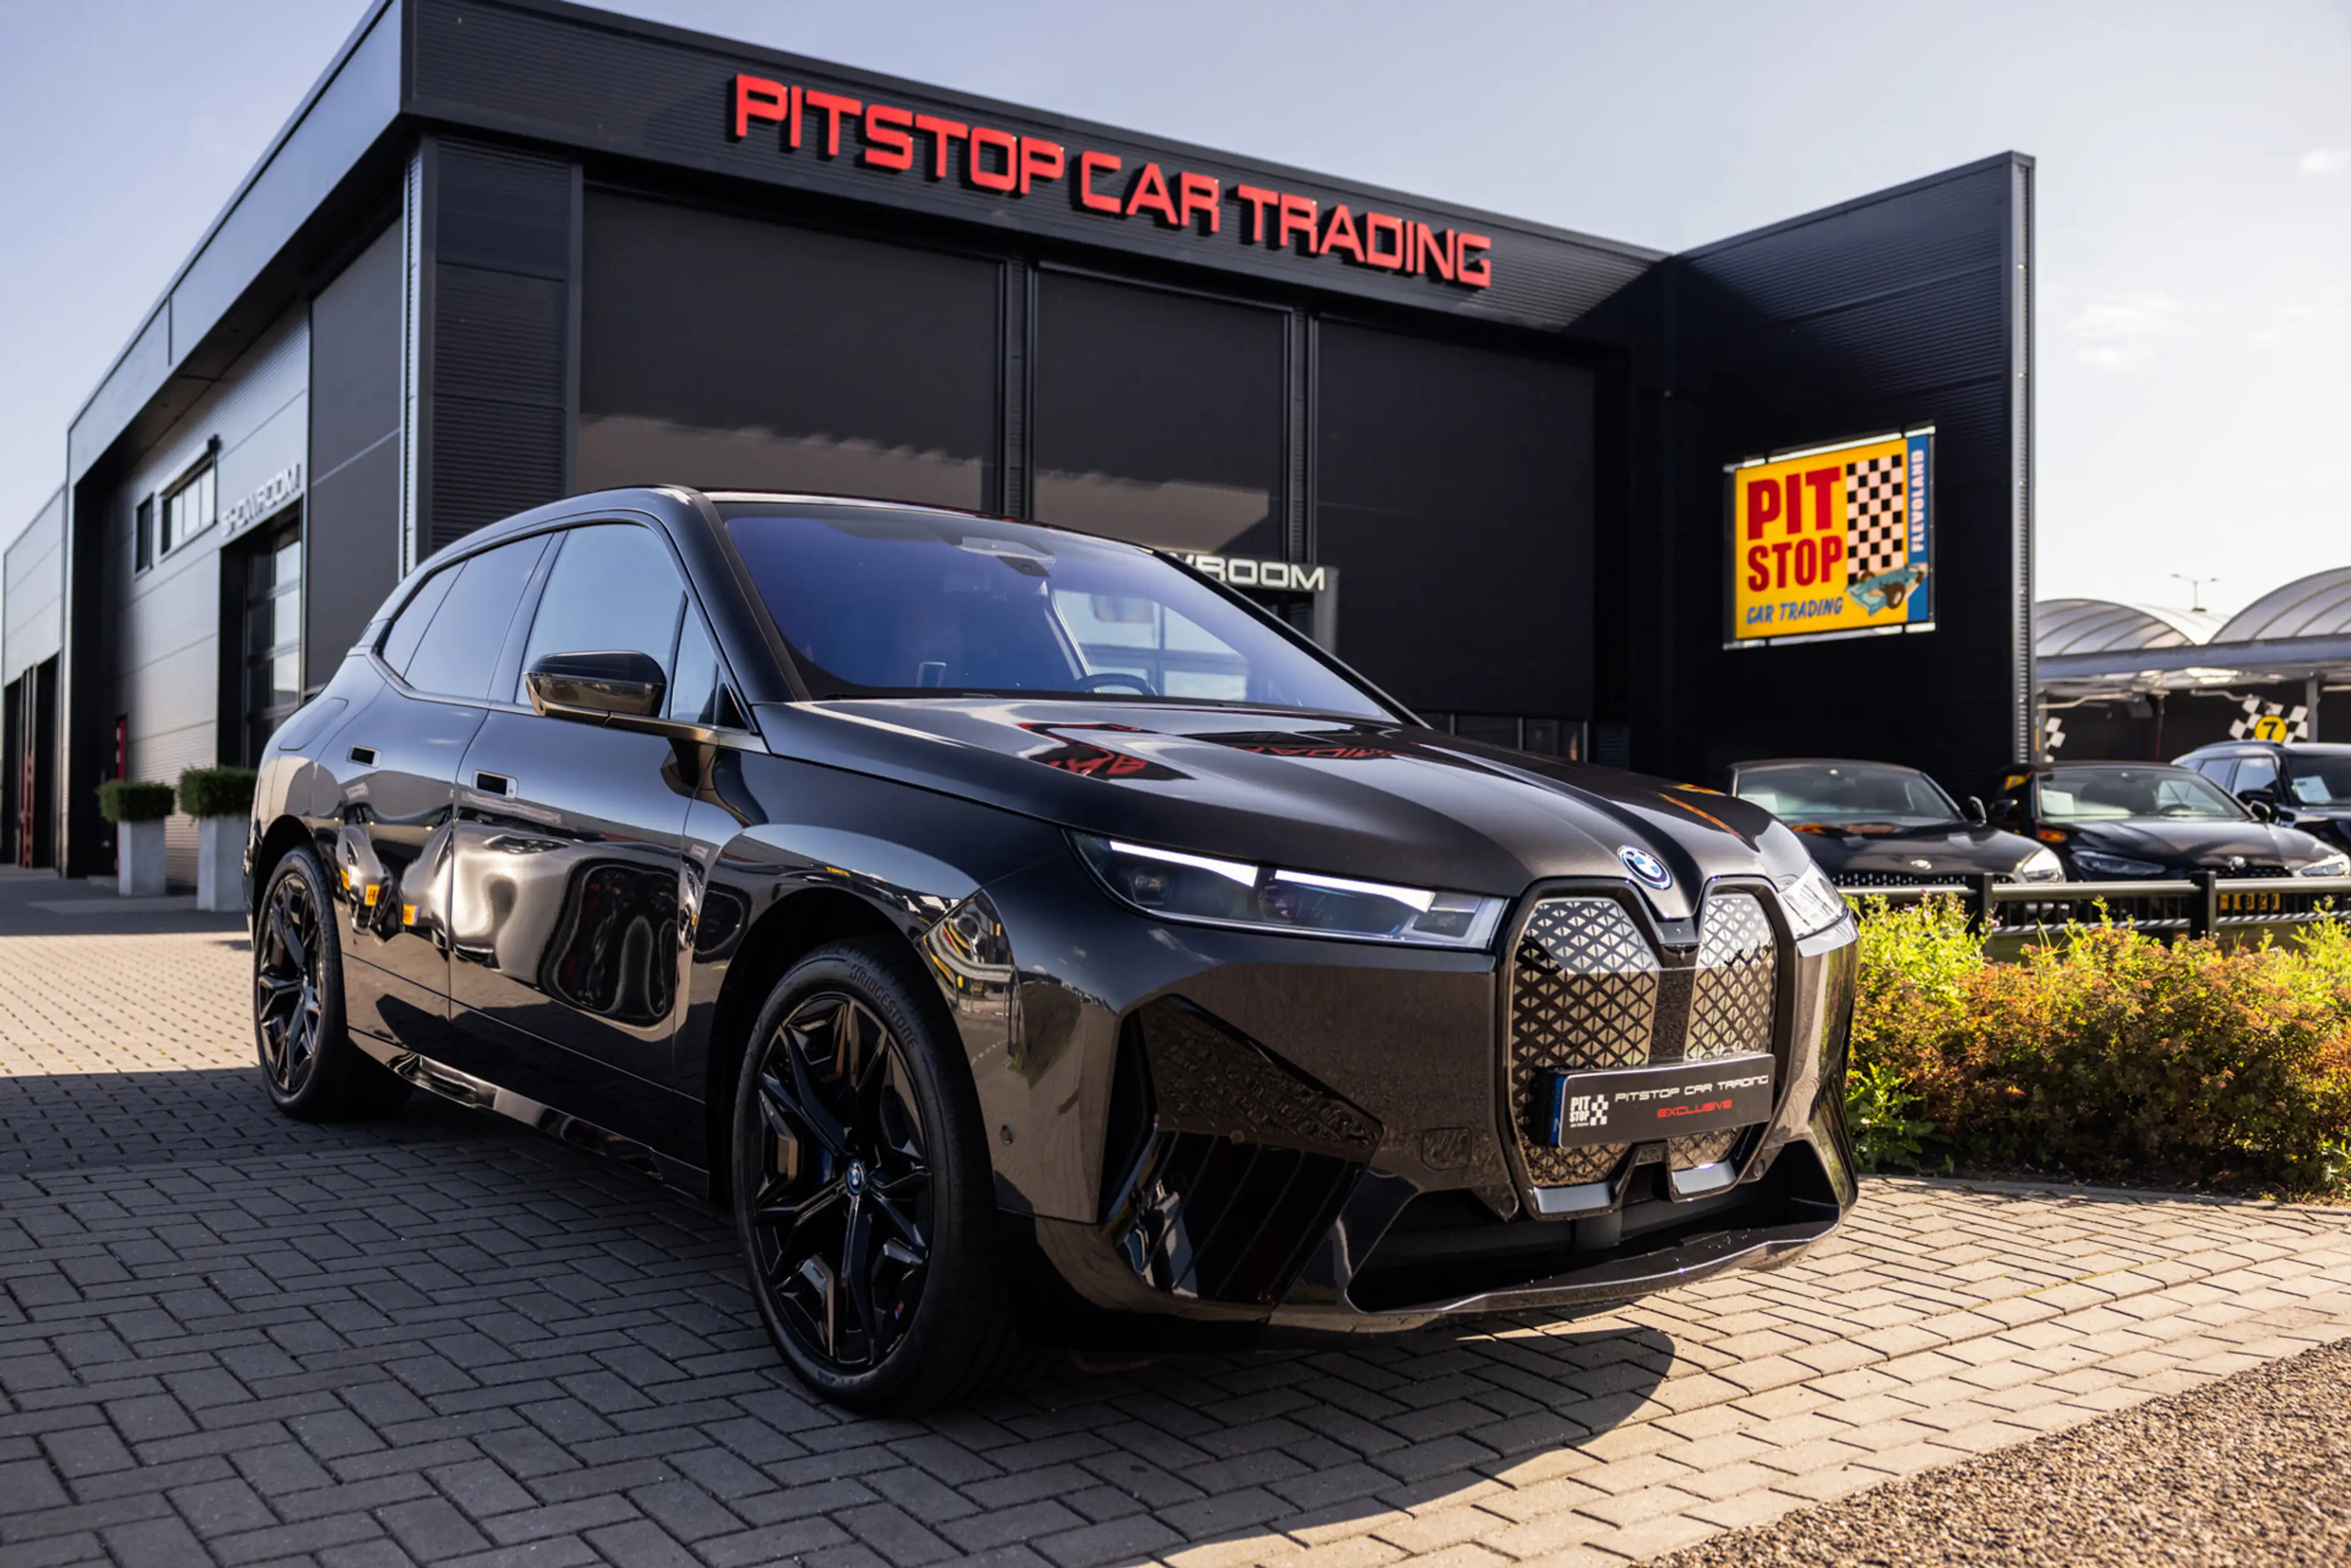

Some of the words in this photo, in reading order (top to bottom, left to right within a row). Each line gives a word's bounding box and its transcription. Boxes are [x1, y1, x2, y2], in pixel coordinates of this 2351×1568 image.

[736, 73, 1065, 195] PITSTOP
[1081, 150, 1220, 233] CAR
[1237, 183, 1492, 288] TRADING
[1747, 466, 1842, 541] PIT
[1910, 448, 1925, 553] FLEVOLAND
[1747, 535, 1843, 593] STOP
[1747, 604, 1775, 626] CAR
[1780, 596, 1843, 622] TRADING
[2262, 721, 2278, 740] 7
[1570, 1095, 1592, 1112] PIT
[1614, 1087, 1681, 1103] PITSTOP
[1684, 1082, 1713, 1096] CAR
[1717, 1075, 1769, 1092] TRADING
[1569, 1109, 1591, 1123] STOP
[1657, 1099, 1733, 1119] EXCLUSIVE
